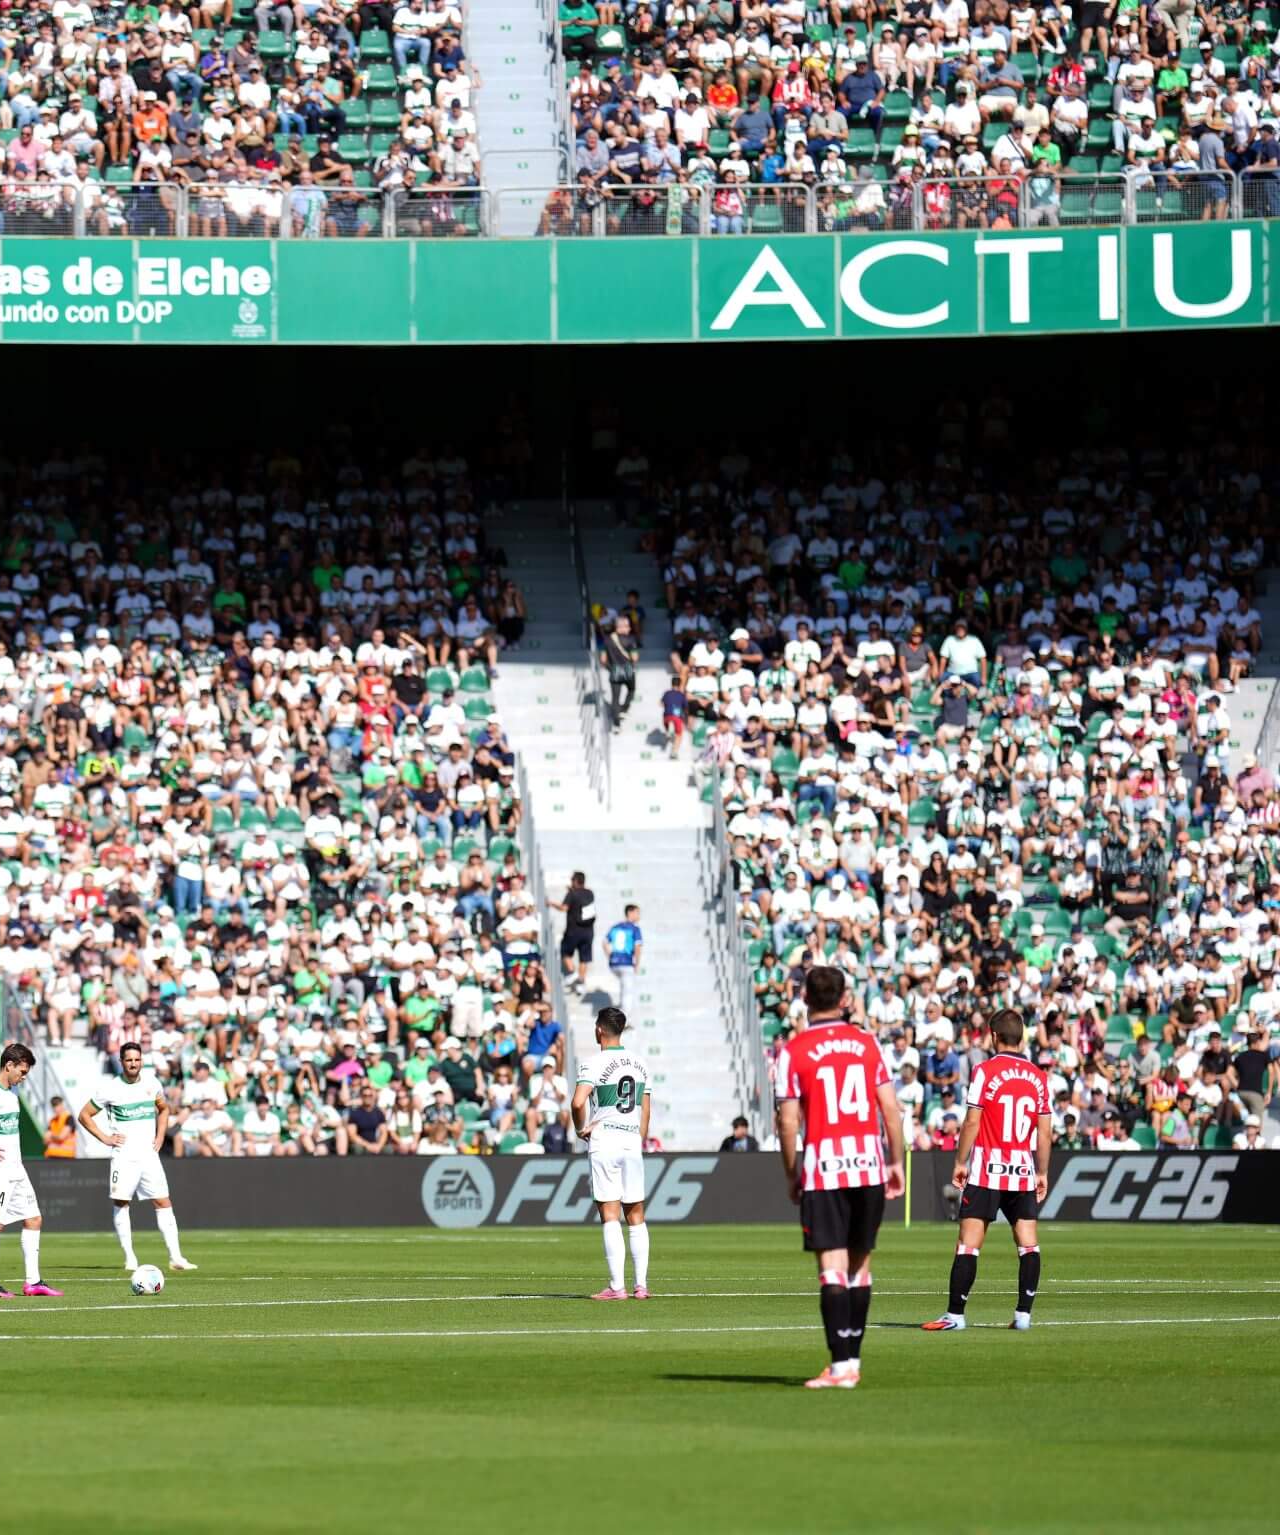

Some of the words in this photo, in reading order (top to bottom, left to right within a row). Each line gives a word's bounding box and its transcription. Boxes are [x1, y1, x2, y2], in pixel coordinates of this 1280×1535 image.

[62, 256, 124, 295] de
[137, 257, 271, 296] Elche
[709, 228, 1252, 331] ACTIU
[64, 303, 109, 323] con
[116, 300, 173, 324] DOP
[620, 1058, 631, 1067] DA
[807, 1039, 866, 1062] LAPORTE
[616, 1075, 636, 1114] 9
[816, 1063, 870, 1125] 14
[998, 1094, 1036, 1143] 16
[112, 1170, 119, 1184] 6
[821, 1157, 877, 1173] DIGI
[988, 1163, 1034, 1176] DIGI
[436, 1169, 480, 1195] EA
[1037, 1155, 1240, 1220] FC26
[434, 1199, 483, 1210] SPORTS
